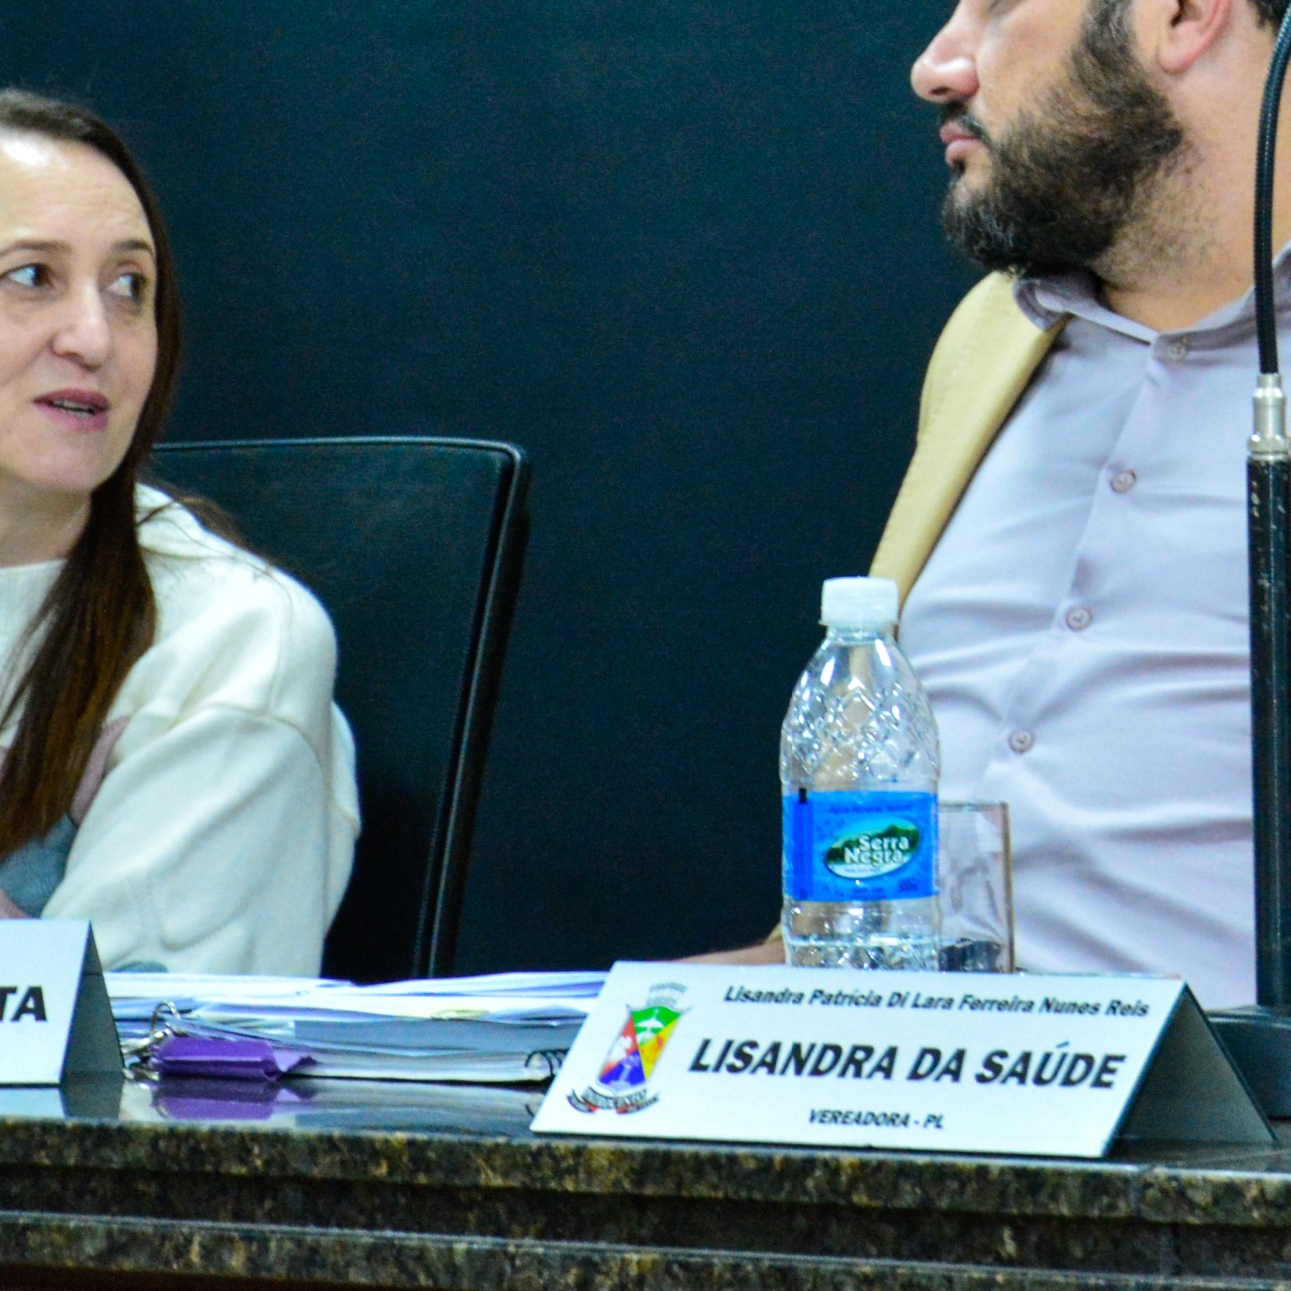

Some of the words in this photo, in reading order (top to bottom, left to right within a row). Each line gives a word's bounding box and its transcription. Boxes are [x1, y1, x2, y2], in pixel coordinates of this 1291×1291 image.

[858, 834, 909, 850] Serra
[844, 847, 903, 868] Negra
[723, 985, 804, 1005] Lisandra
[886, 990, 910, 1008] Di
[911, 991, 954, 1010] Lara
[958, 994, 1034, 1013] Ferreira
[1038, 996, 1102, 1015] Nunes
[1105, 999, 1150, 1017] Reis
[689, 1038, 898, 1080] LISANDRA
[906, 1046, 966, 1082] DA
[975, 1040, 1127, 1089] SAÚDE
[809, 1109, 910, 1128] VEREADORA
[923, 1113, 945, 1129] PL
